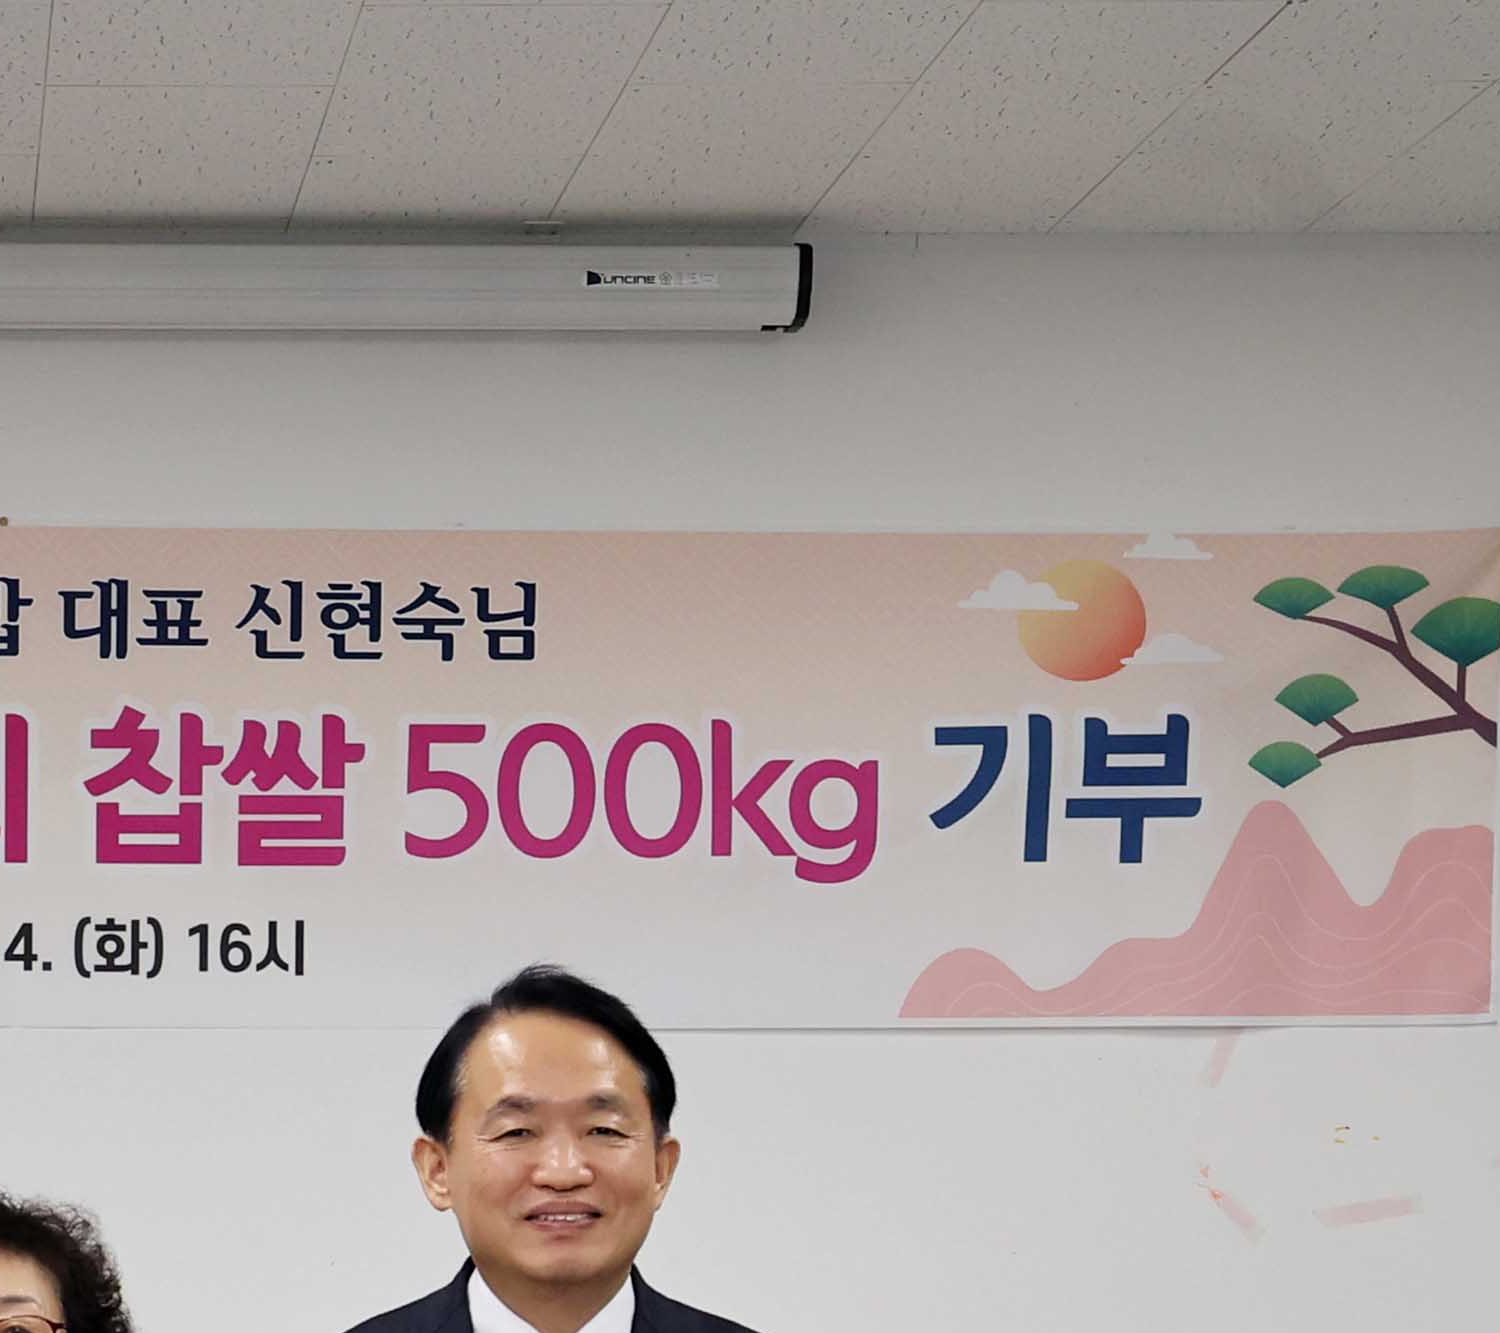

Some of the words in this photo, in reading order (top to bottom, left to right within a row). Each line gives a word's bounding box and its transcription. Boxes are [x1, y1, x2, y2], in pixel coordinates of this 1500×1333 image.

[57, 577, 209, 660] 대표
[235, 579, 537, 662] 신현숙님
[82, 704, 366, 867] 찹쌀
[404, 718, 879, 884] 500kg
[928, 713, 1203, 864] 기부
[74, 916, 164, 979] (화)
[188, 919, 305, 977] 16시
